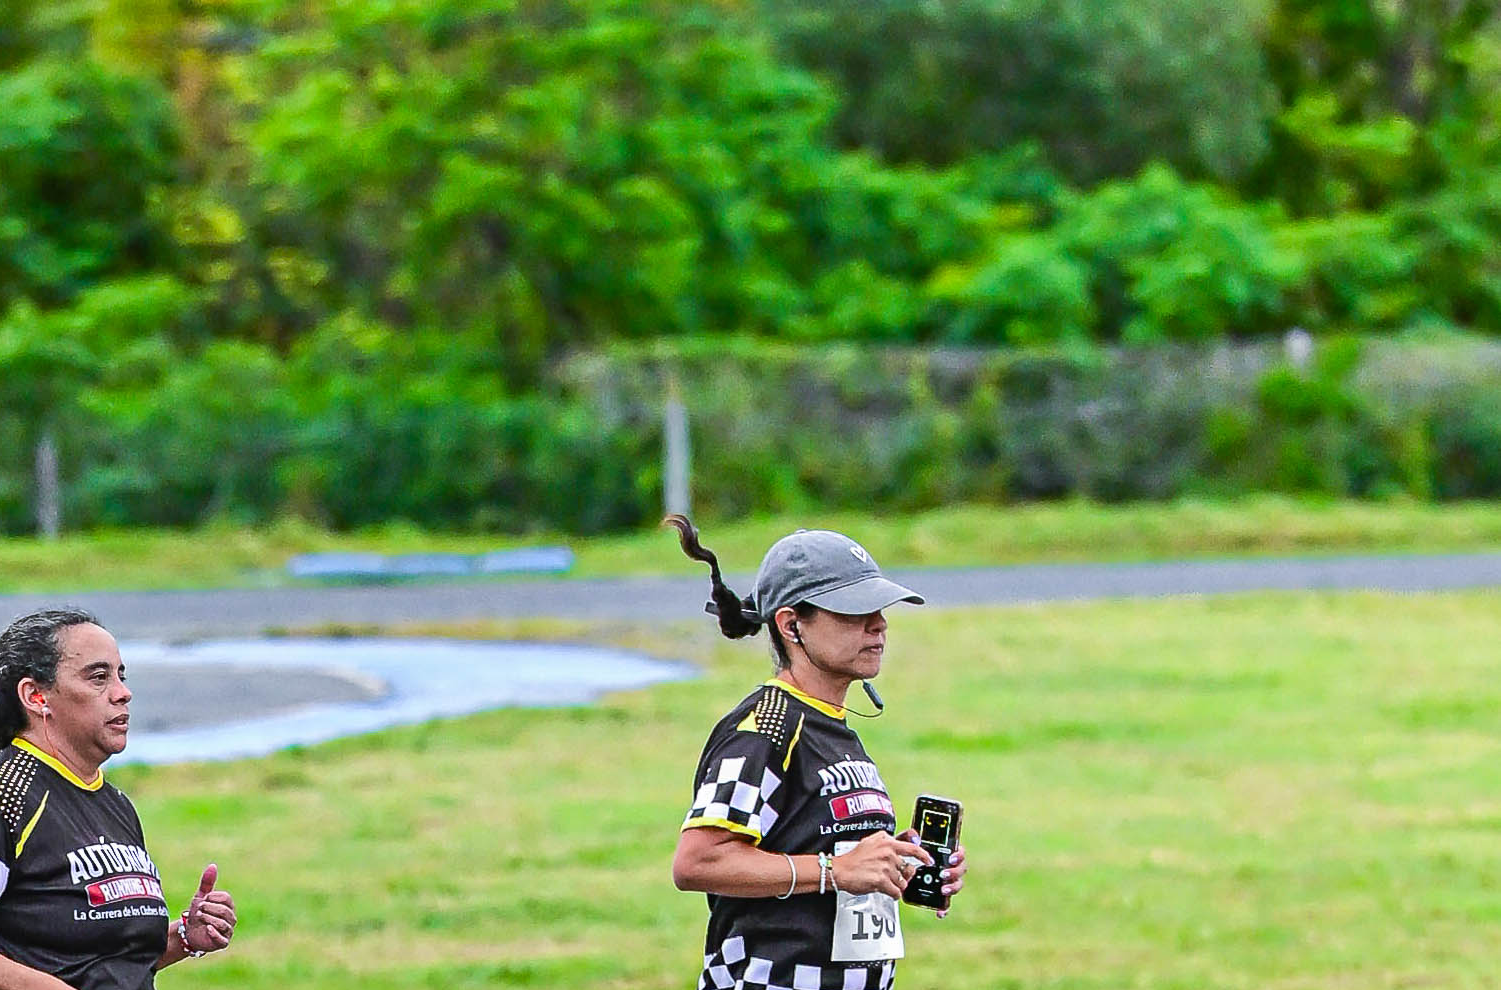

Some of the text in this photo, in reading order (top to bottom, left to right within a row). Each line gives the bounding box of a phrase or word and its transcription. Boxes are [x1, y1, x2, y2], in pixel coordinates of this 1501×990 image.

[820, 825, 832, 835] La
[73, 910, 86, 920] La
[88, 909, 122, 920] Carrera
